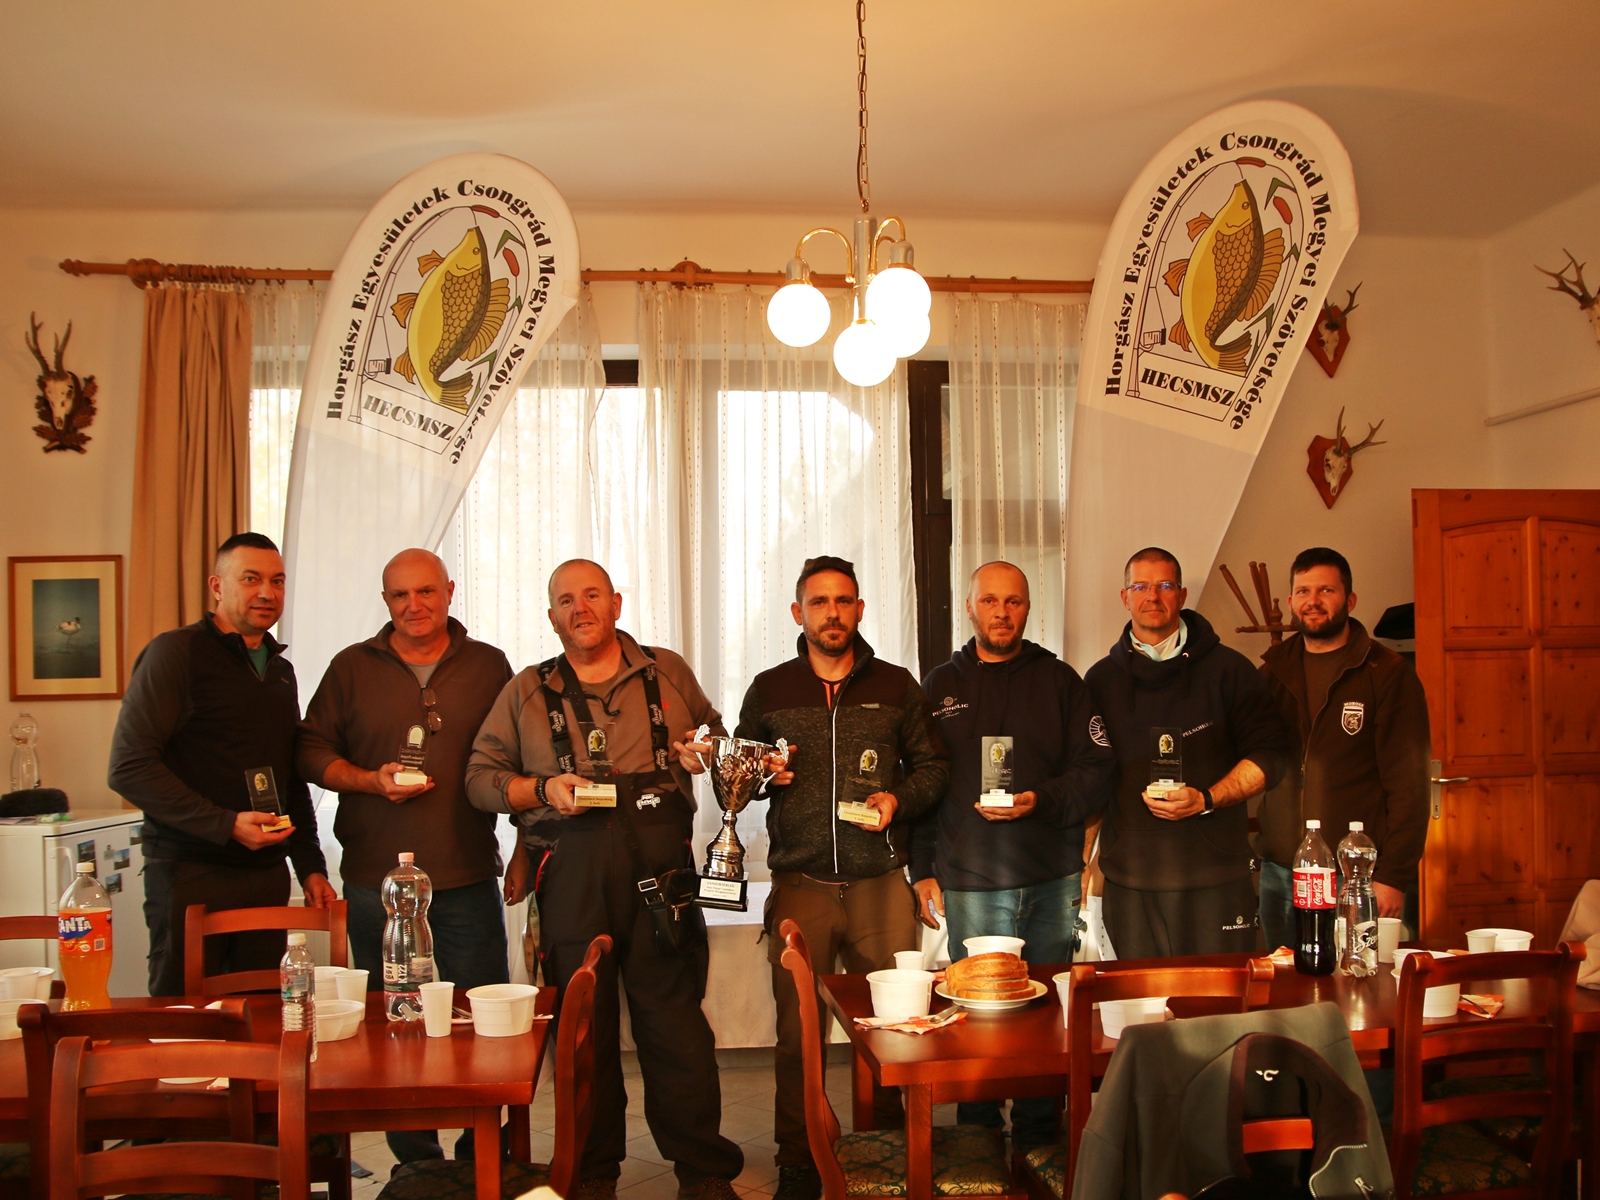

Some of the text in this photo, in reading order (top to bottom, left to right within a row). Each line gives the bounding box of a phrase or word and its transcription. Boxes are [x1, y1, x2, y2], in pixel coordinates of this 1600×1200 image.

[326, 318, 362, 420] Horgász
[352, 186, 451, 312] Egyesületek
[457, 179, 552, 248] Csongrád
[526, 254, 556, 341] Megyei
[1105, 132, 1332, 430] Horgász Egyesületek Csongrád Megyei Szövetsége
[363, 394, 455, 441] HECSMSZ
[1140, 367, 1235, 407] HECSMSZ
